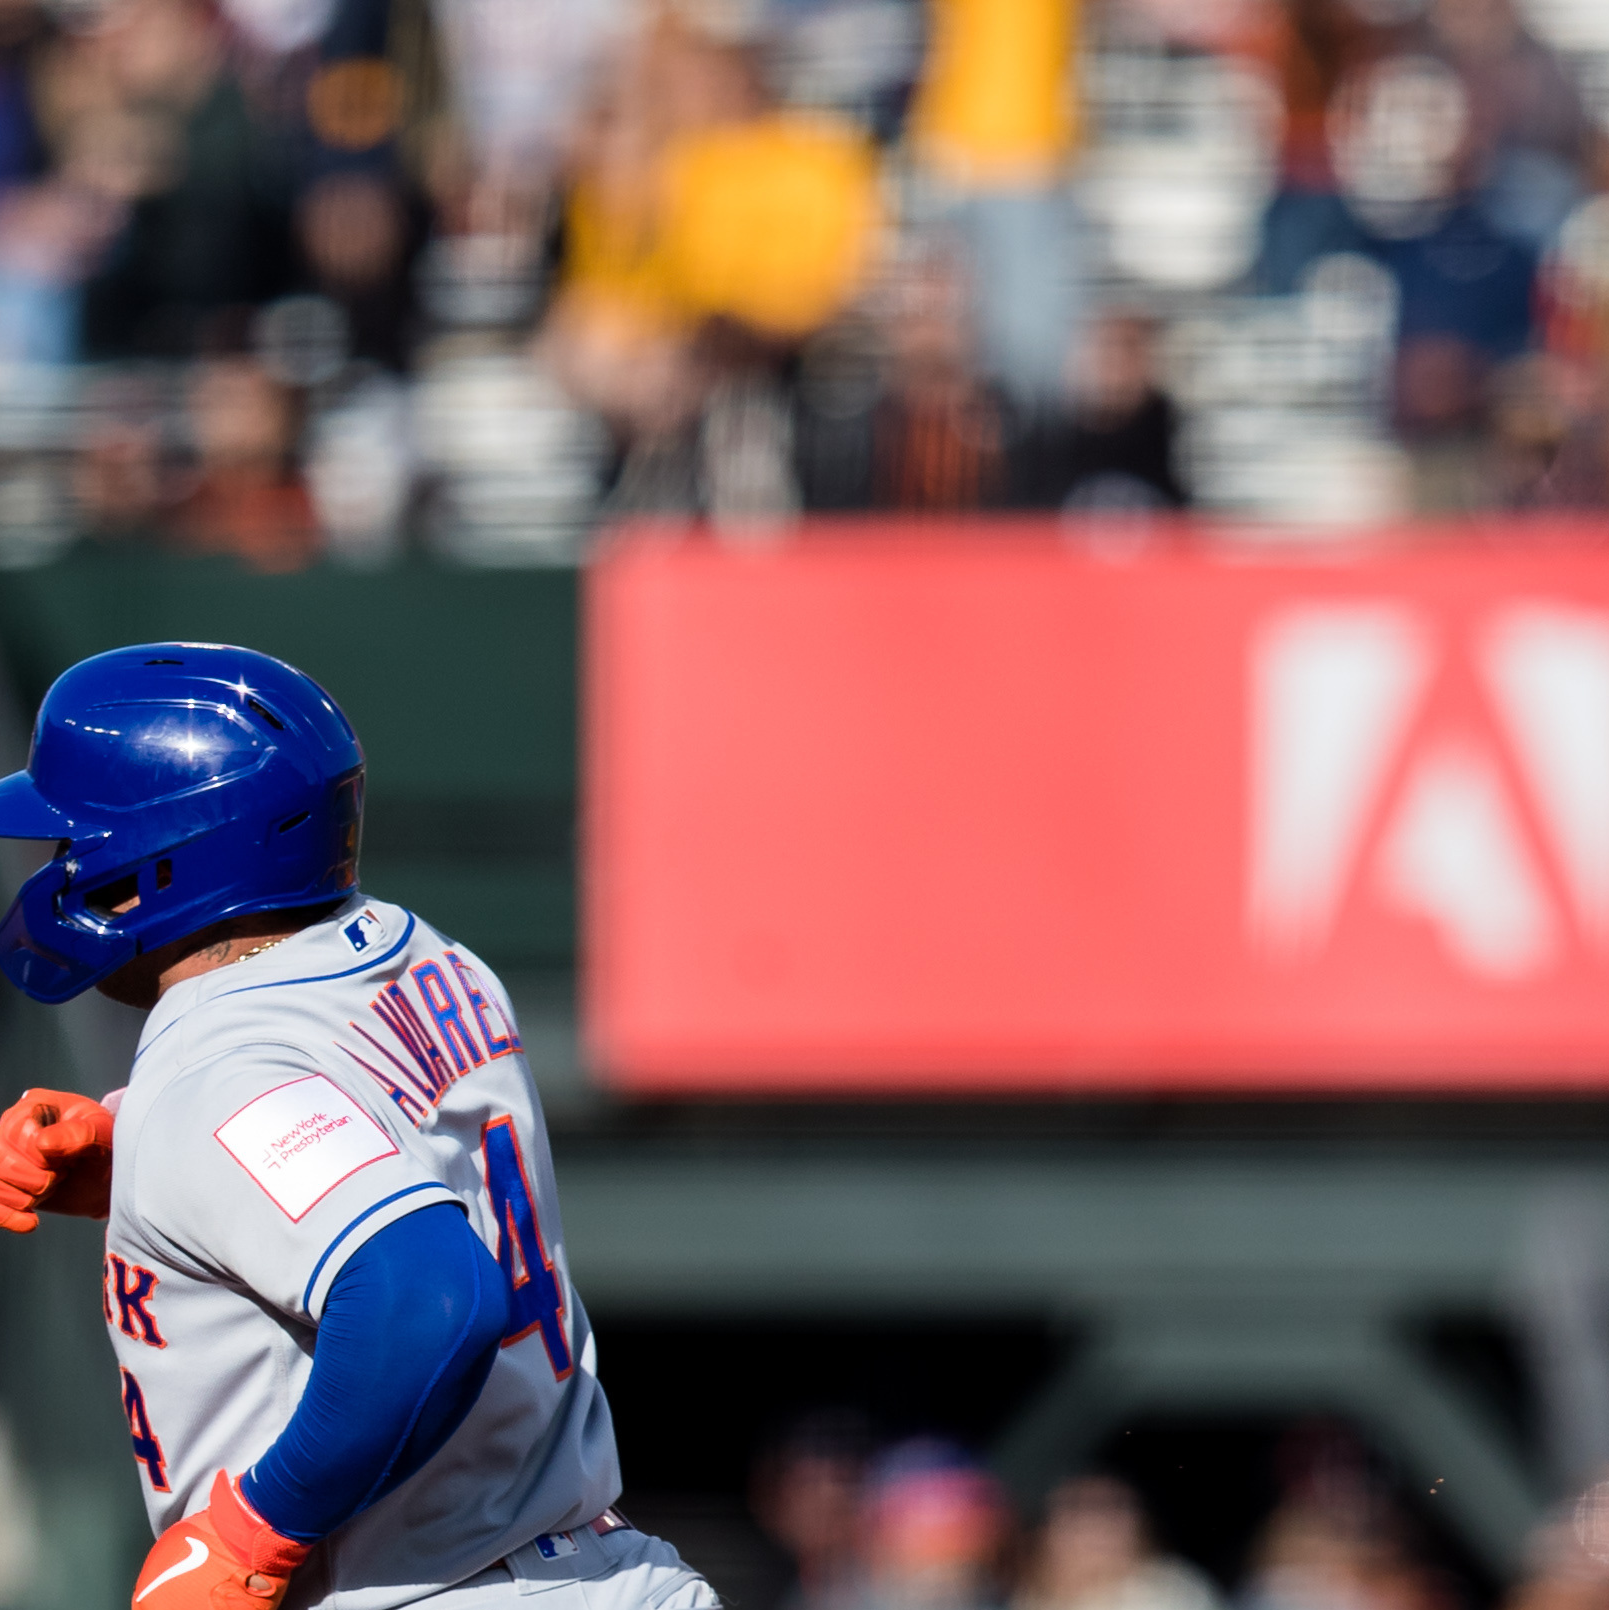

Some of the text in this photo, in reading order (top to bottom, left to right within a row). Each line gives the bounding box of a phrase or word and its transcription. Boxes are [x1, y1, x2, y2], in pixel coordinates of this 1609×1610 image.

[333, 951, 523, 1128] ALVARE
[279, 1115, 353, 1163] Presbyterian
[103, 1253, 168, 1349] K
[480, 1113, 574, 1383] 4
[119, 1365, 173, 1493] 4
